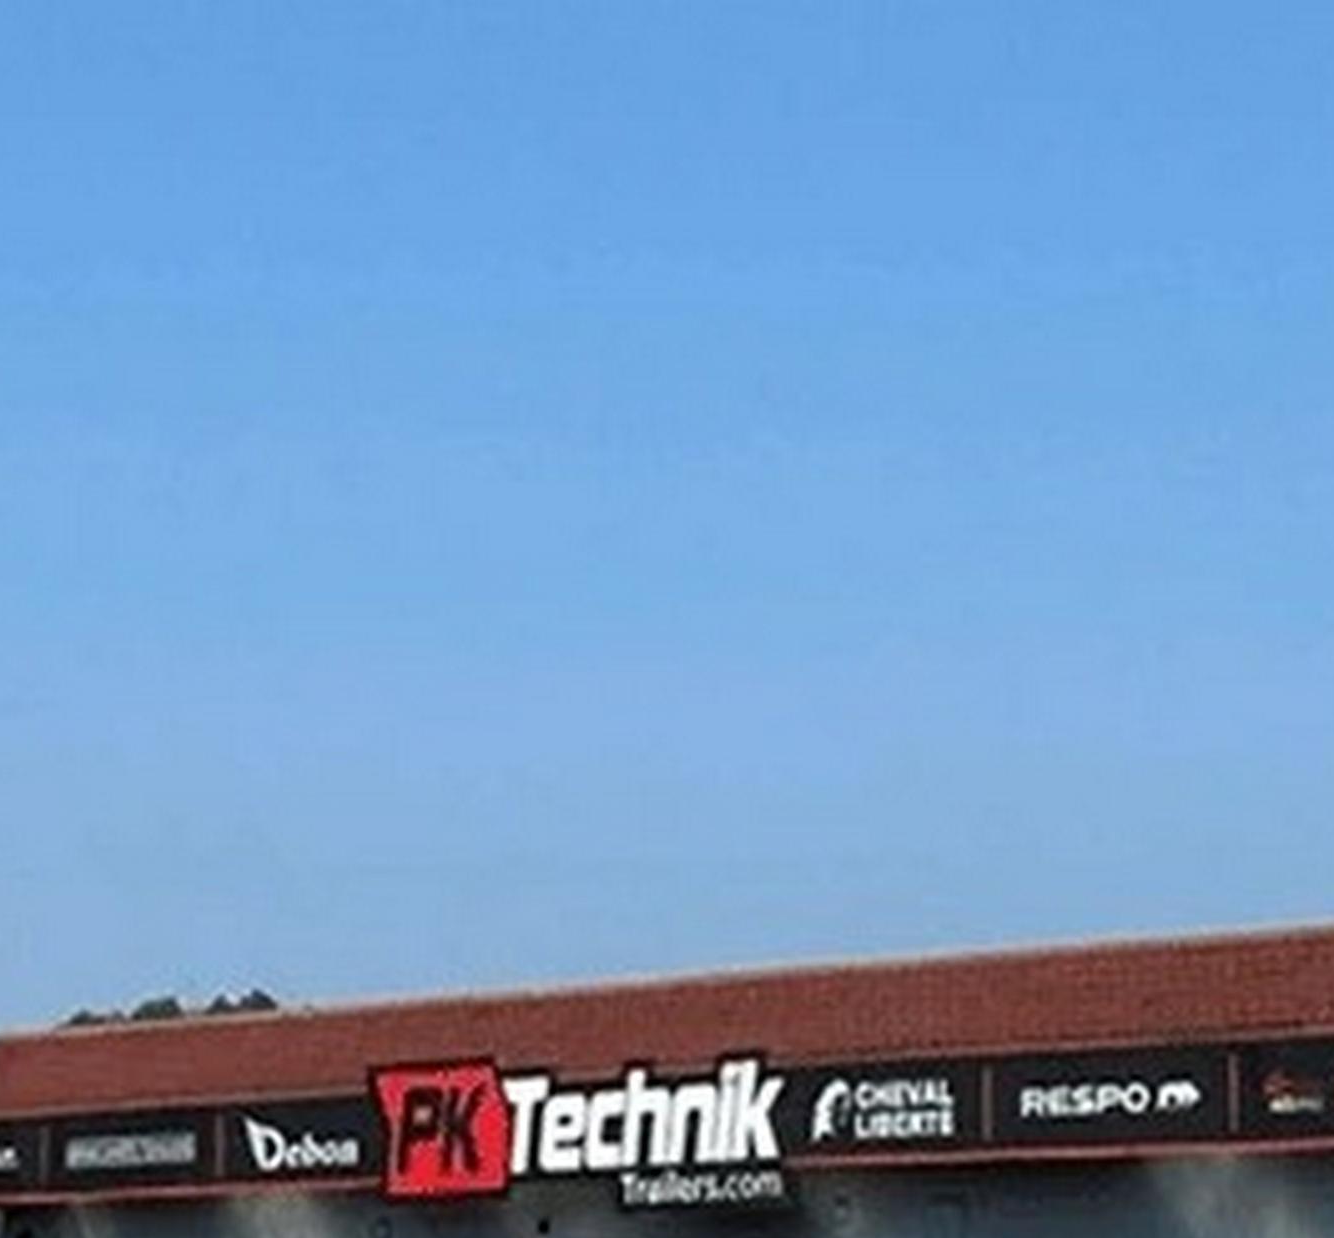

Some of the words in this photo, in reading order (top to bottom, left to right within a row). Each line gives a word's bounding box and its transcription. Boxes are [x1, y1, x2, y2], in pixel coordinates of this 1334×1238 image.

[854, 1079, 953, 1109] CHEVAL
[1020, 1082, 1151, 1118] RESPO
[396, 1082, 489, 1179] PK
[501, 1060, 784, 1176] Technik
[620, 1169, 783, 1205] Trailers.com
